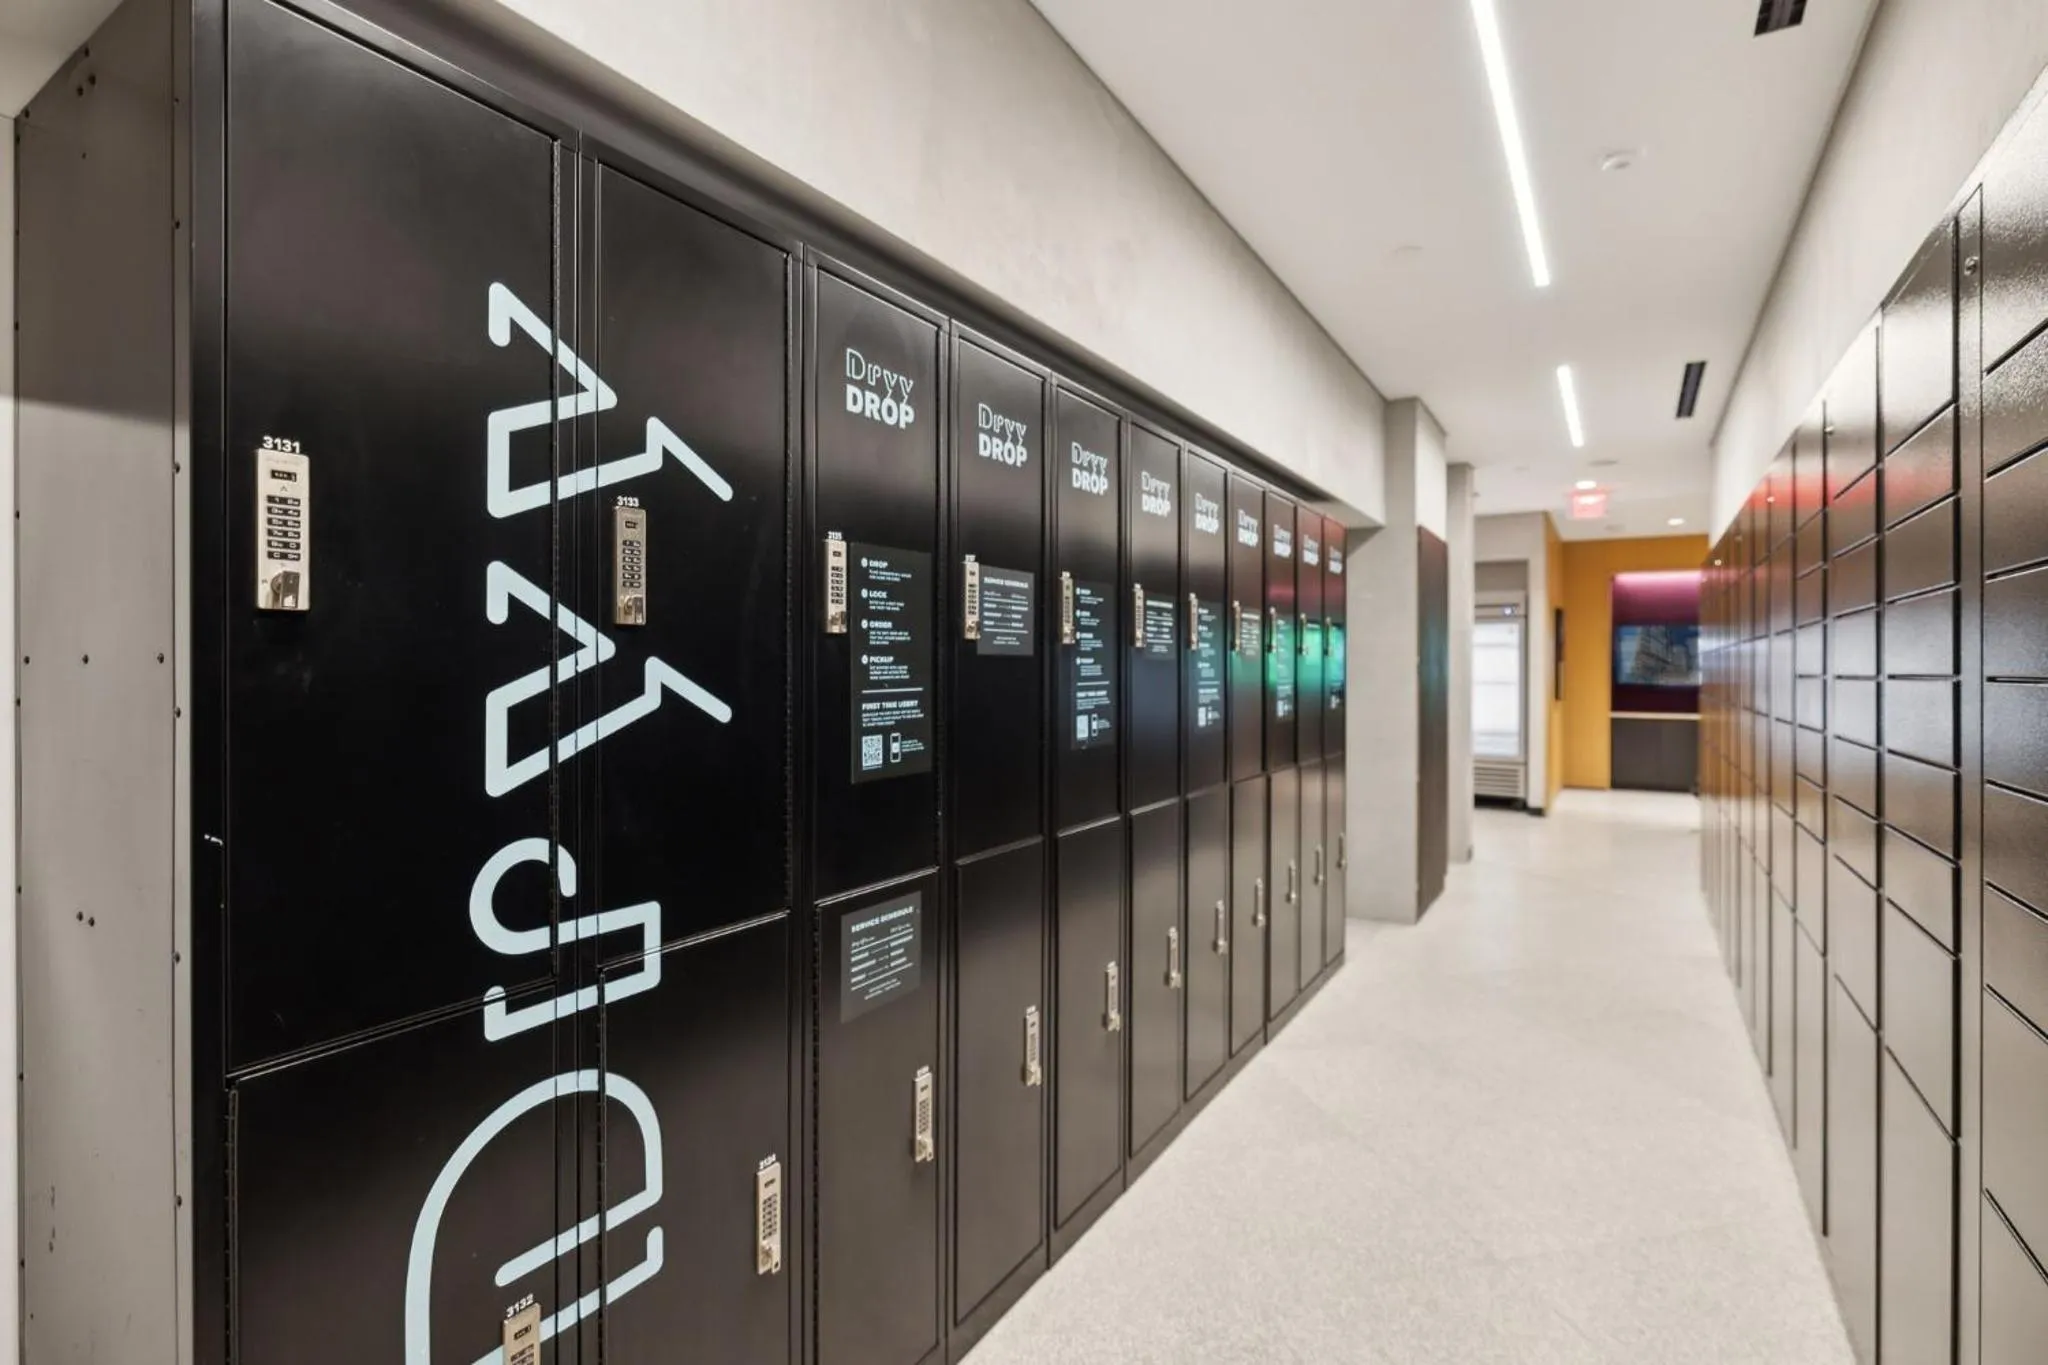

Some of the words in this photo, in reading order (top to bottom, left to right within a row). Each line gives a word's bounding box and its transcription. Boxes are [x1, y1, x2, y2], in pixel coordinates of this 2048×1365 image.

[846, 384, 915, 430] DROP
[263, 436, 300, 454] 3131
[978, 433, 1028, 467] DROP
[1072, 468, 1109, 496] DROP
[617, 496, 640, 507] 3133
[1142, 493, 1172, 518] DROP
[505, 1293, 534, 1318] 3132
